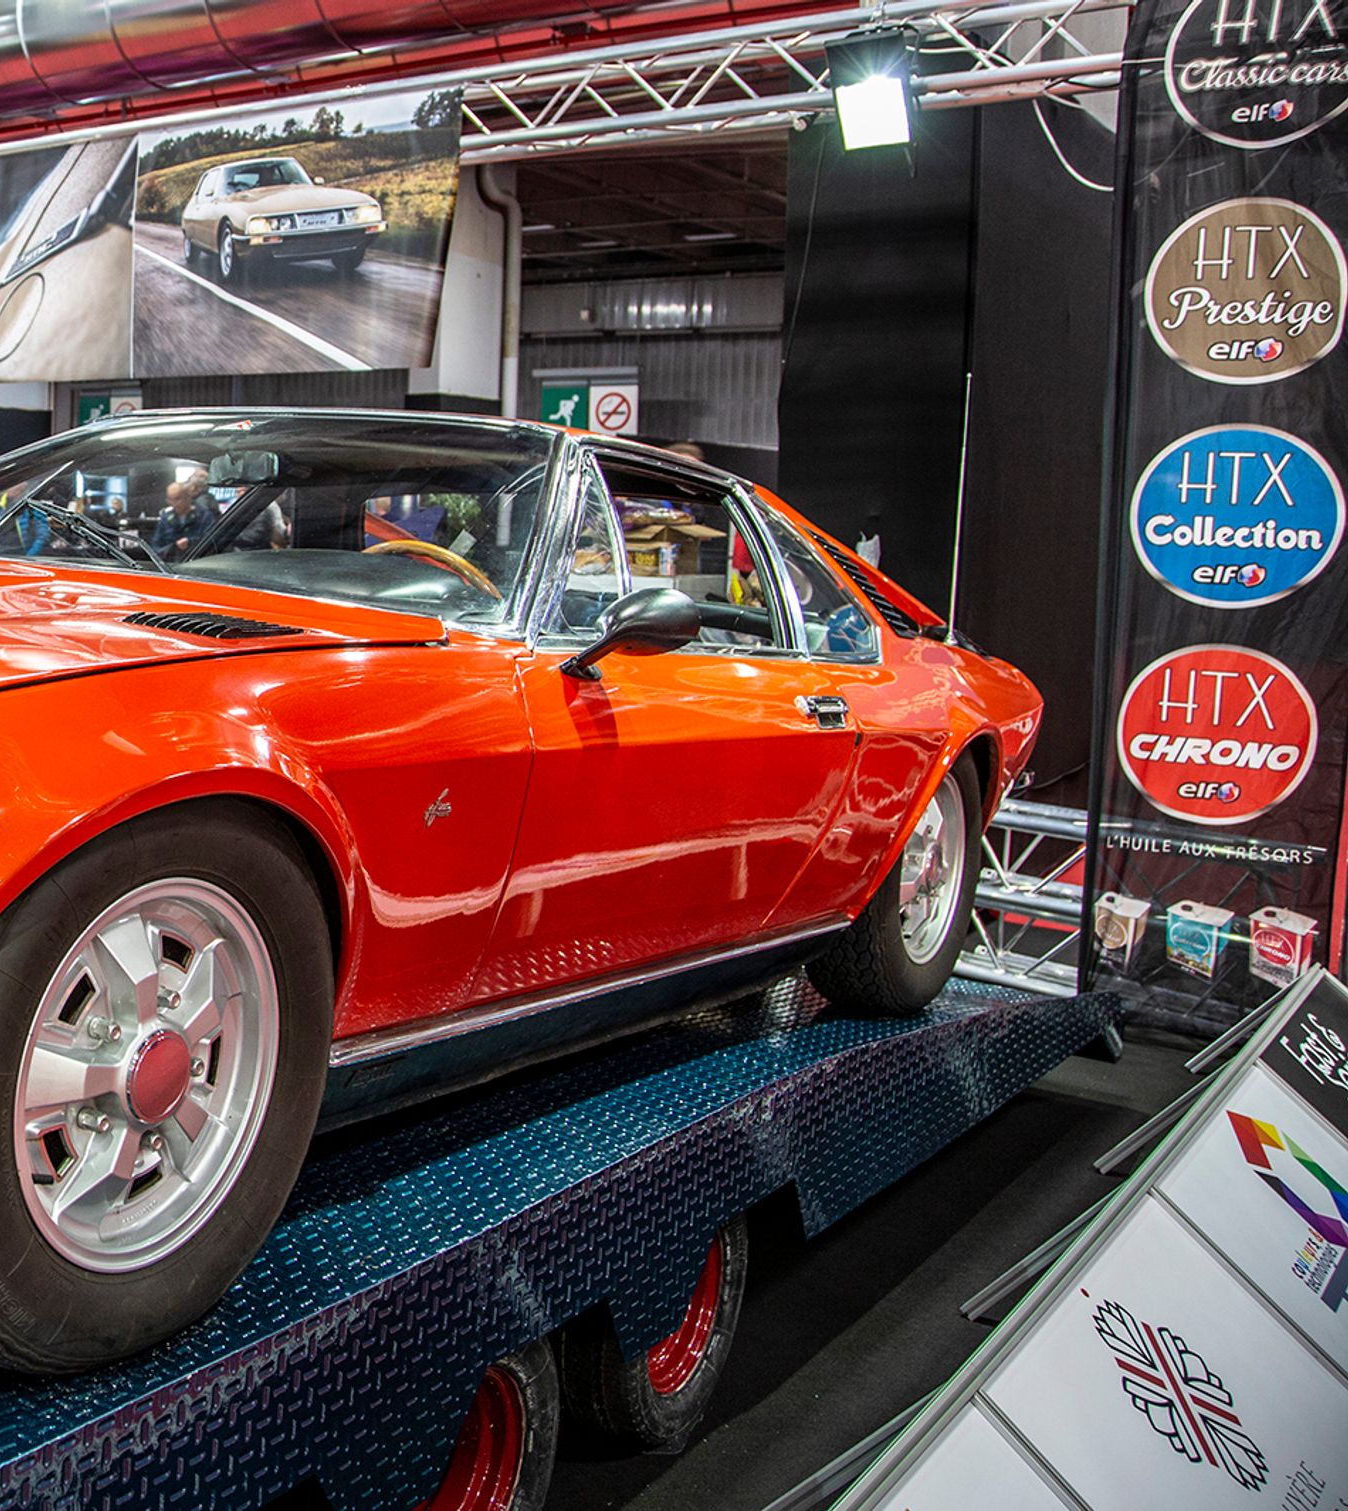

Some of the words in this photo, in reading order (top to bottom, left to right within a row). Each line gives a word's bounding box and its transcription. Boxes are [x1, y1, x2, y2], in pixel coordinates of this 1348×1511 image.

[1178, 57, 1288, 92] Classic
[1230, 103, 1269, 123] elf
[1193, 225, 1310, 280] HTX
[1162, 286, 1334, 337] Prestige
[1208, 340, 1256, 360] elf
[1178, 451, 1294, 506] HTX
[1144, 514, 1324, 551] Collection
[1192, 564, 1239, 584] elf
[1158, 667, 1276, 731] HTX
[1129, 732, 1302, 772] CHRONO
[1178, 782, 1218, 800] elf
[1106, 834, 1172, 854] L'HUILE
[1179, 841, 1217, 859] AUX
[1224, 845, 1314, 865] TRÉSORS
[1279, 1022, 1339, 1085] Fast
[1292, 1237, 1321, 1280] couleurs
